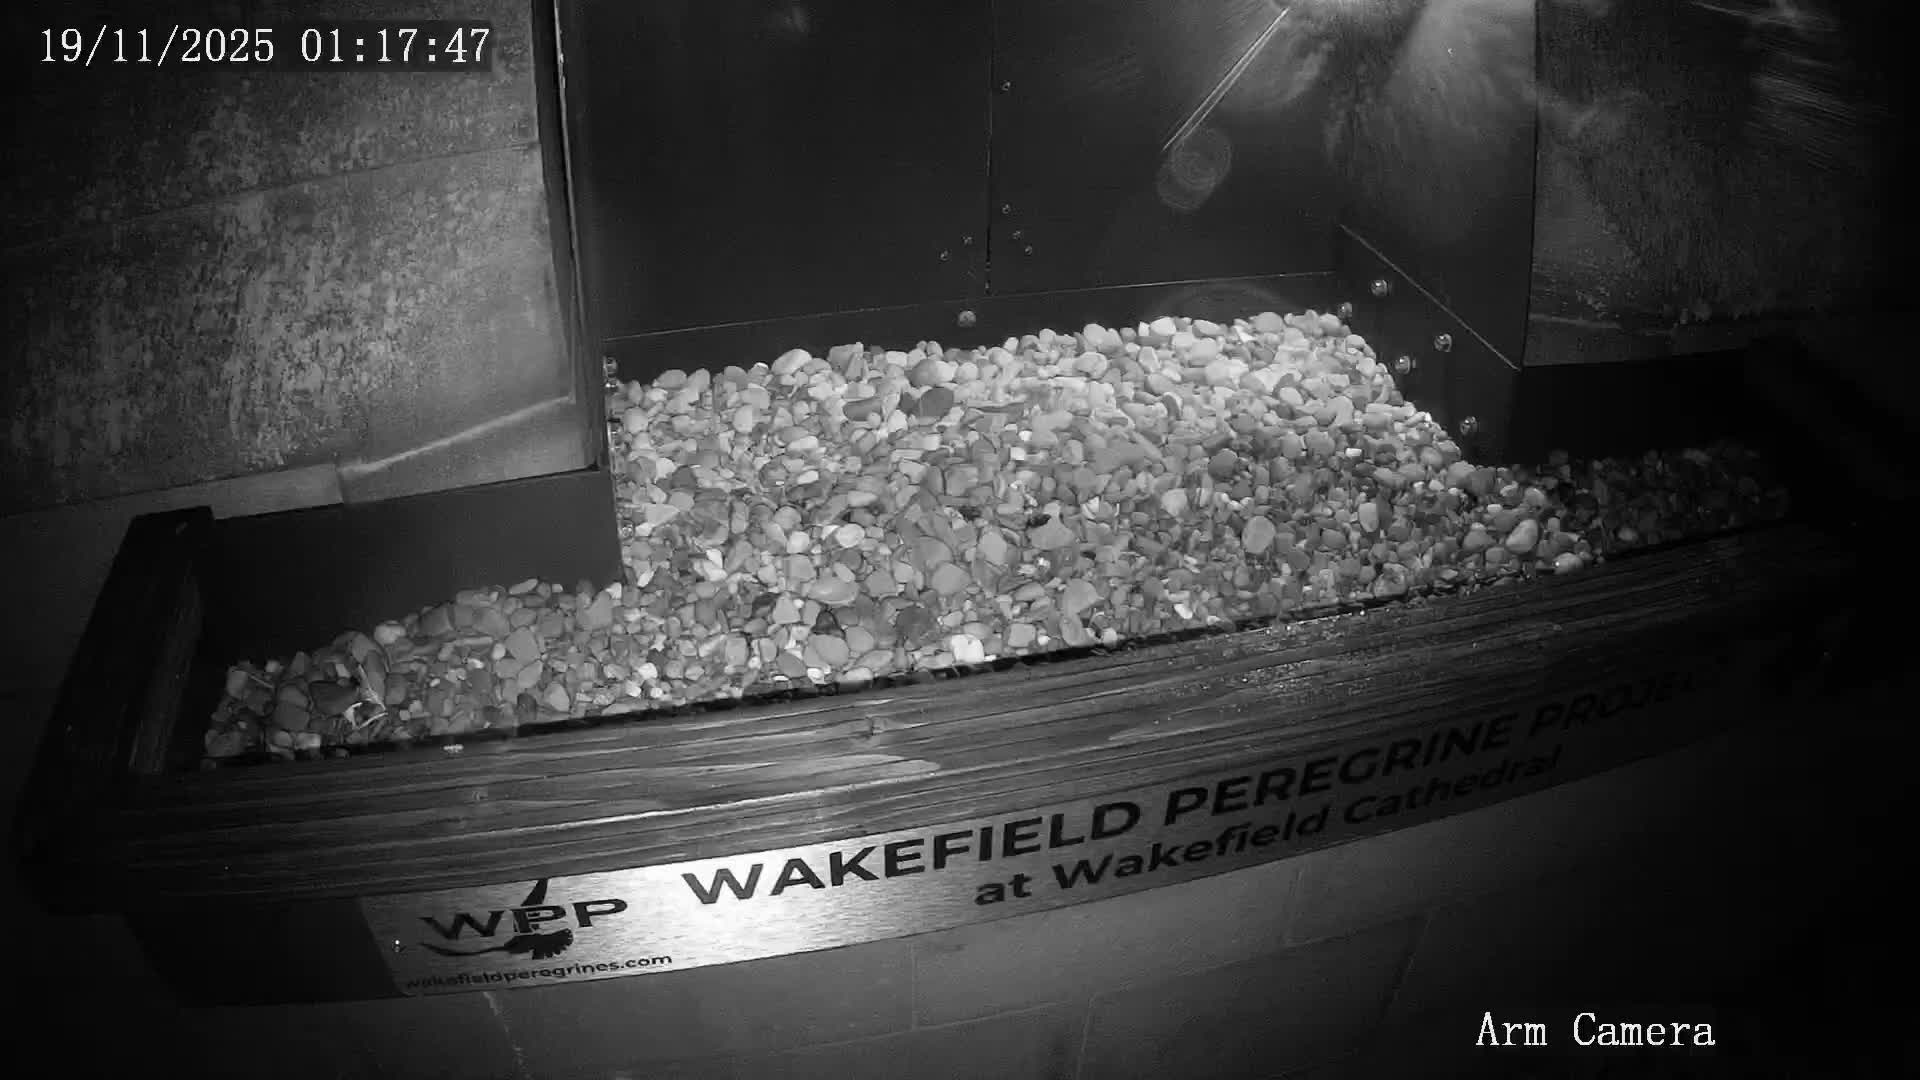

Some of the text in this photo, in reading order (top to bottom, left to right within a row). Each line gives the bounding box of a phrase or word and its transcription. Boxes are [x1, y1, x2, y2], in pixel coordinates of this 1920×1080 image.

[683, 668, 1704, 906] WAKEFIELD PEREGRINE PROJE
[974, 744, 1562, 906] at Wakefield Cathedral
[420, 898, 628, 940] WPP
[406, 954, 672, 989] wakefieldperegrines.com
